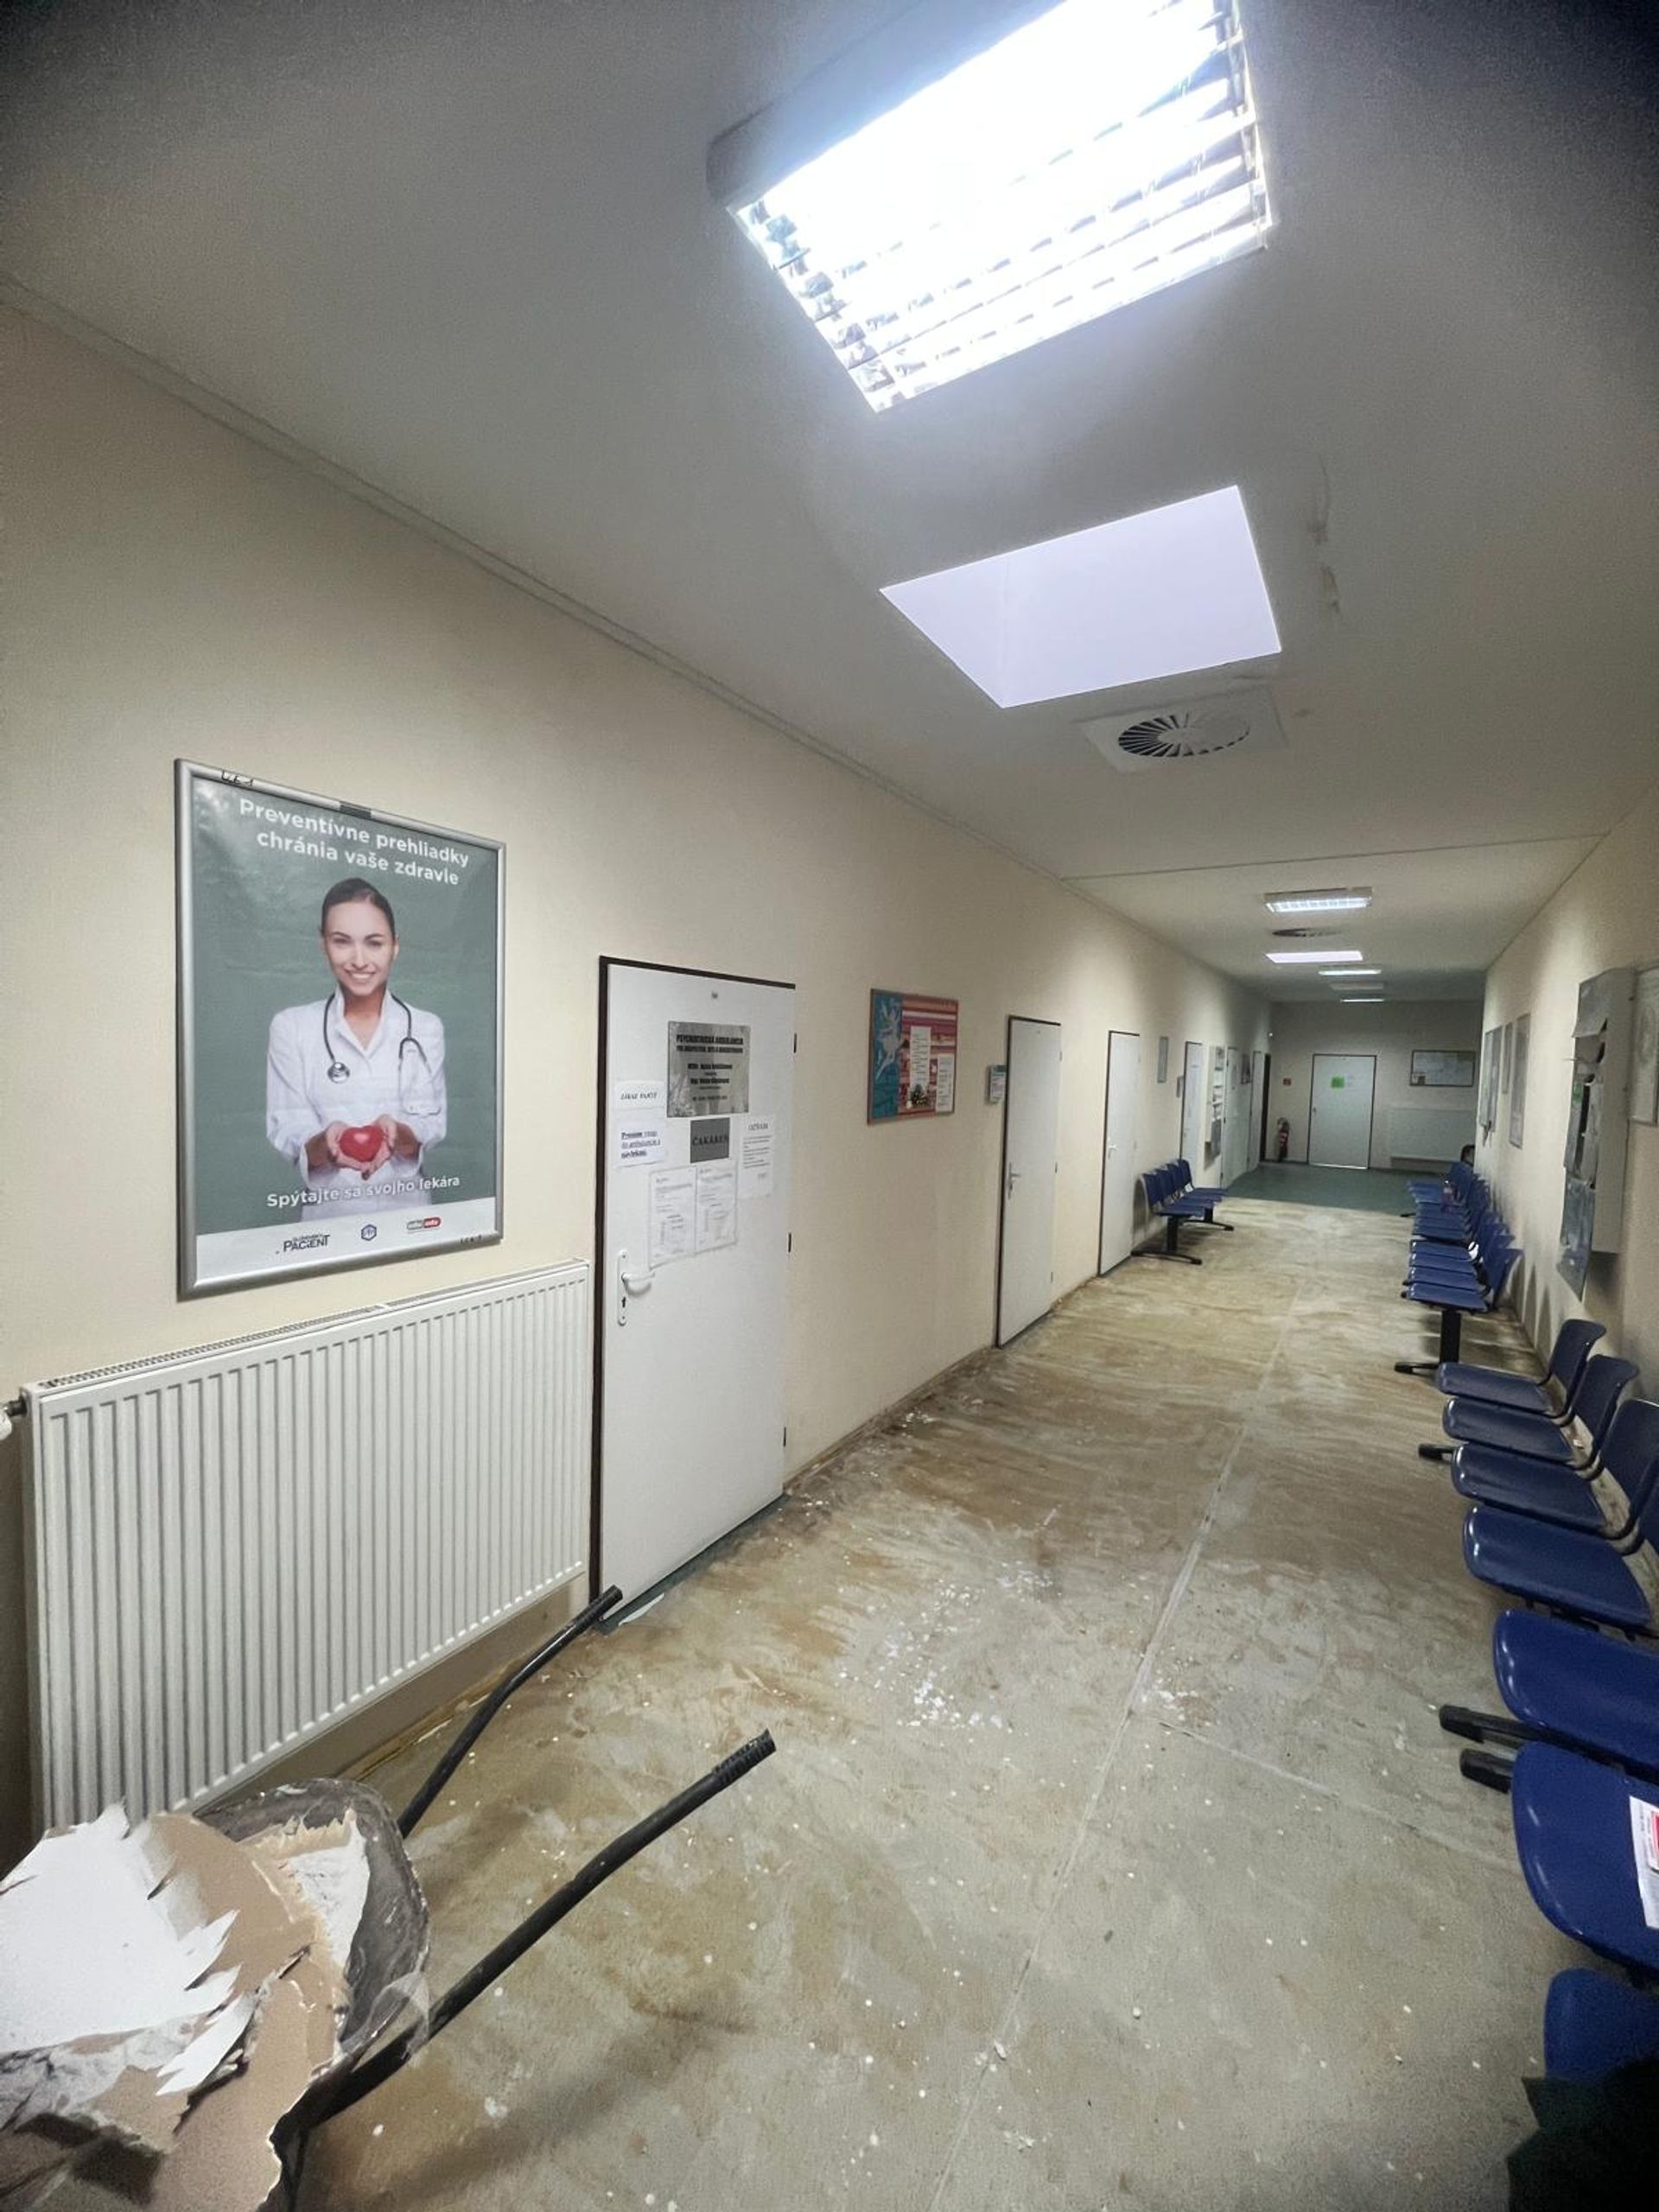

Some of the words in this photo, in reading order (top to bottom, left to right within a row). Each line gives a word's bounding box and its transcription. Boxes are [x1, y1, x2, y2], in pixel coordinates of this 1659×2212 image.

[240, 798, 370, 843] Preventívne
[376, 834, 468, 868] prehliadky
[257, 830, 338, 861] chránia
[345, 849, 388, 871] vaše
[394, 861, 459, 885] zdravie
[266, 1187, 340, 1208] Spýtajte
[344, 1187, 360, 1200] sa
[366, 1179, 415, 1196] svojho
[419, 1176, 460, 1191] lekára
